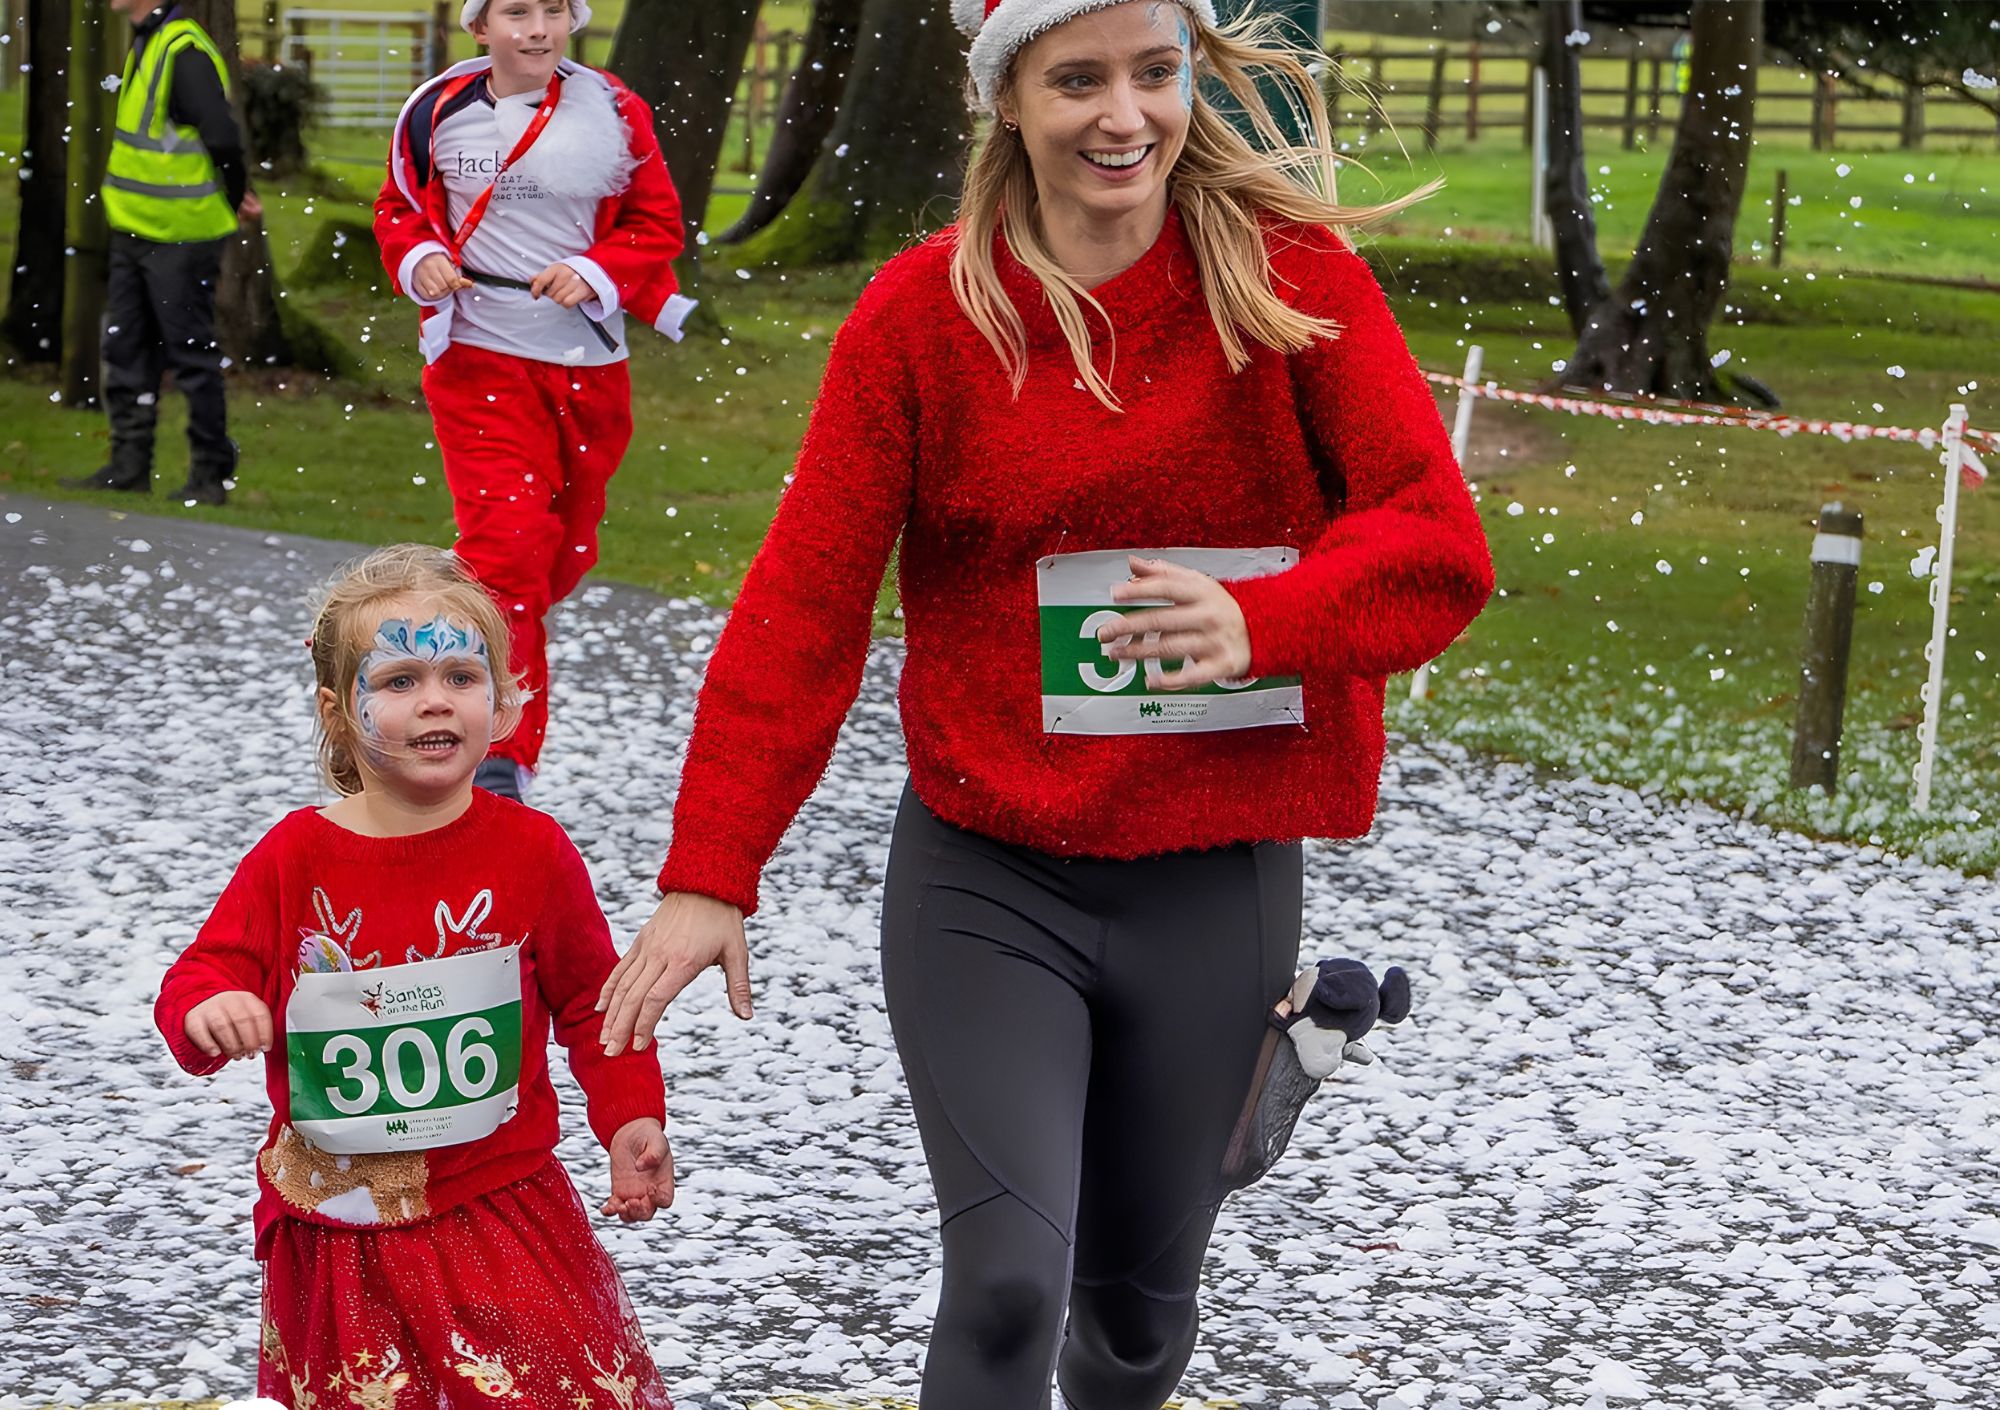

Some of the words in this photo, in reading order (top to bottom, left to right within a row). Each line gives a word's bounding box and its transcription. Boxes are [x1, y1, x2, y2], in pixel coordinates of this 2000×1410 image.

[385, 985, 442, 1004] Santas
[420, 999, 445, 1011] Run
[322, 1016, 499, 1115] 306
